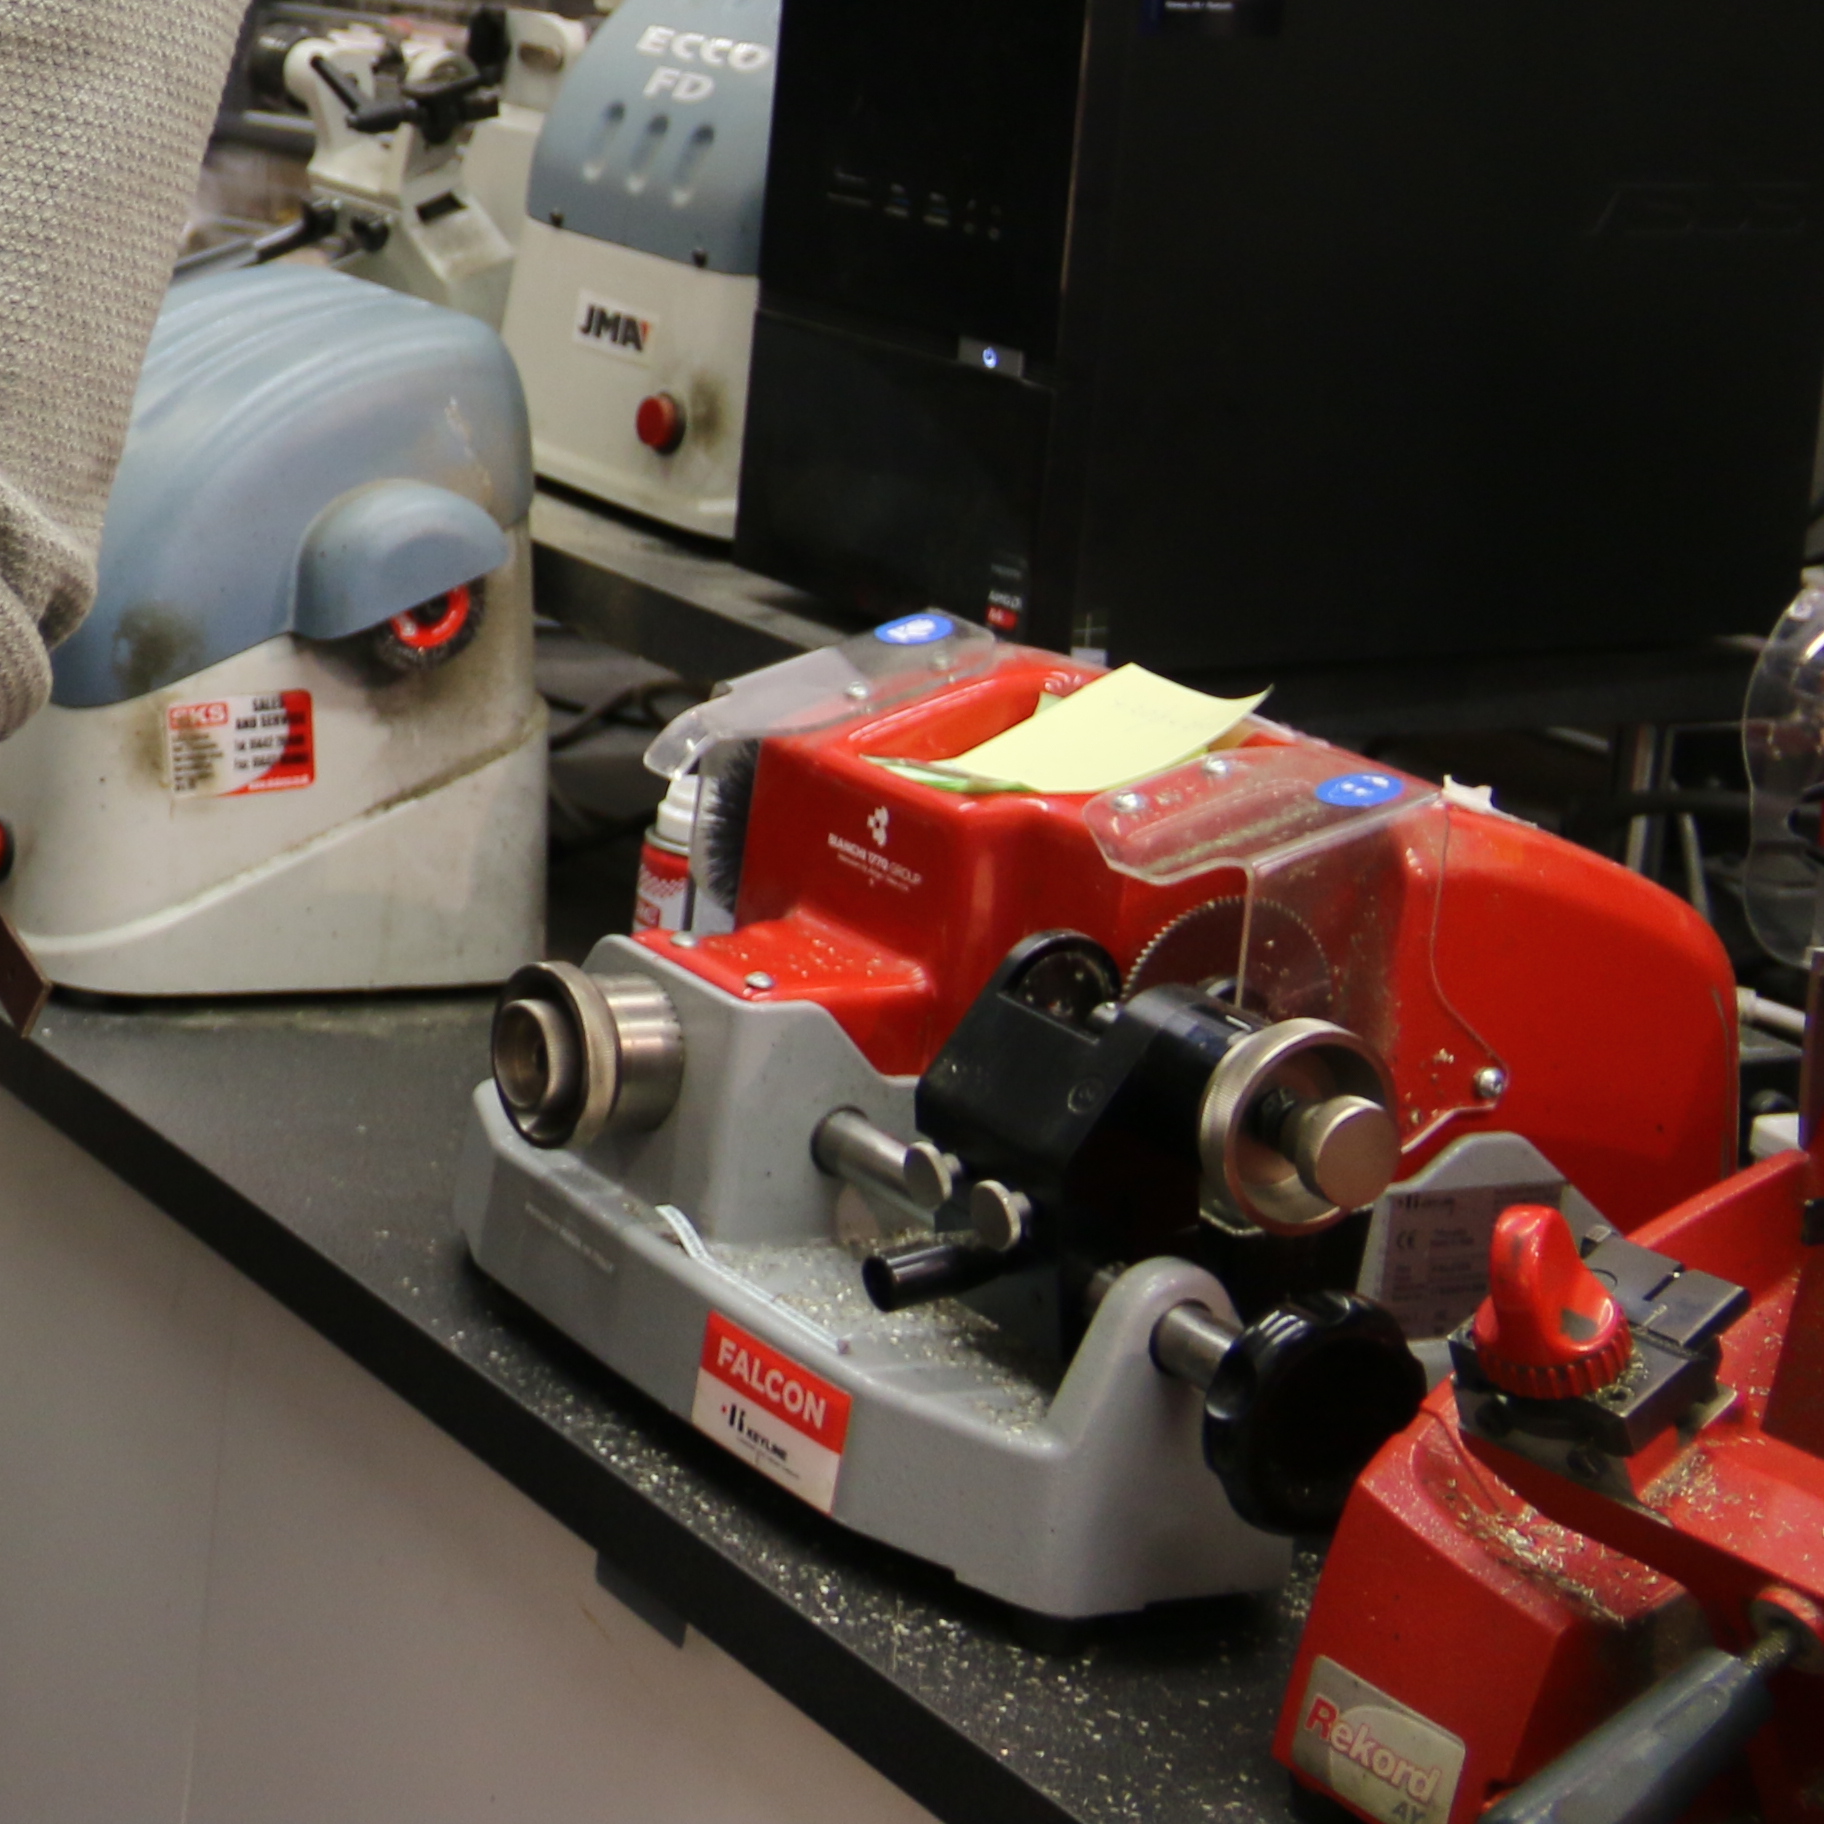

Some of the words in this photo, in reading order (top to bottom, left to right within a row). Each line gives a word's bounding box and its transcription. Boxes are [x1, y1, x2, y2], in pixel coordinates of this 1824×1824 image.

[636, 25, 773, 72] ECCO
[642, 65, 715, 103] FD
[579, 304, 646, 353] JMA
[717, 1336, 827, 1430] FALCON
[1305, 1692, 1443, 1806] Rekord
